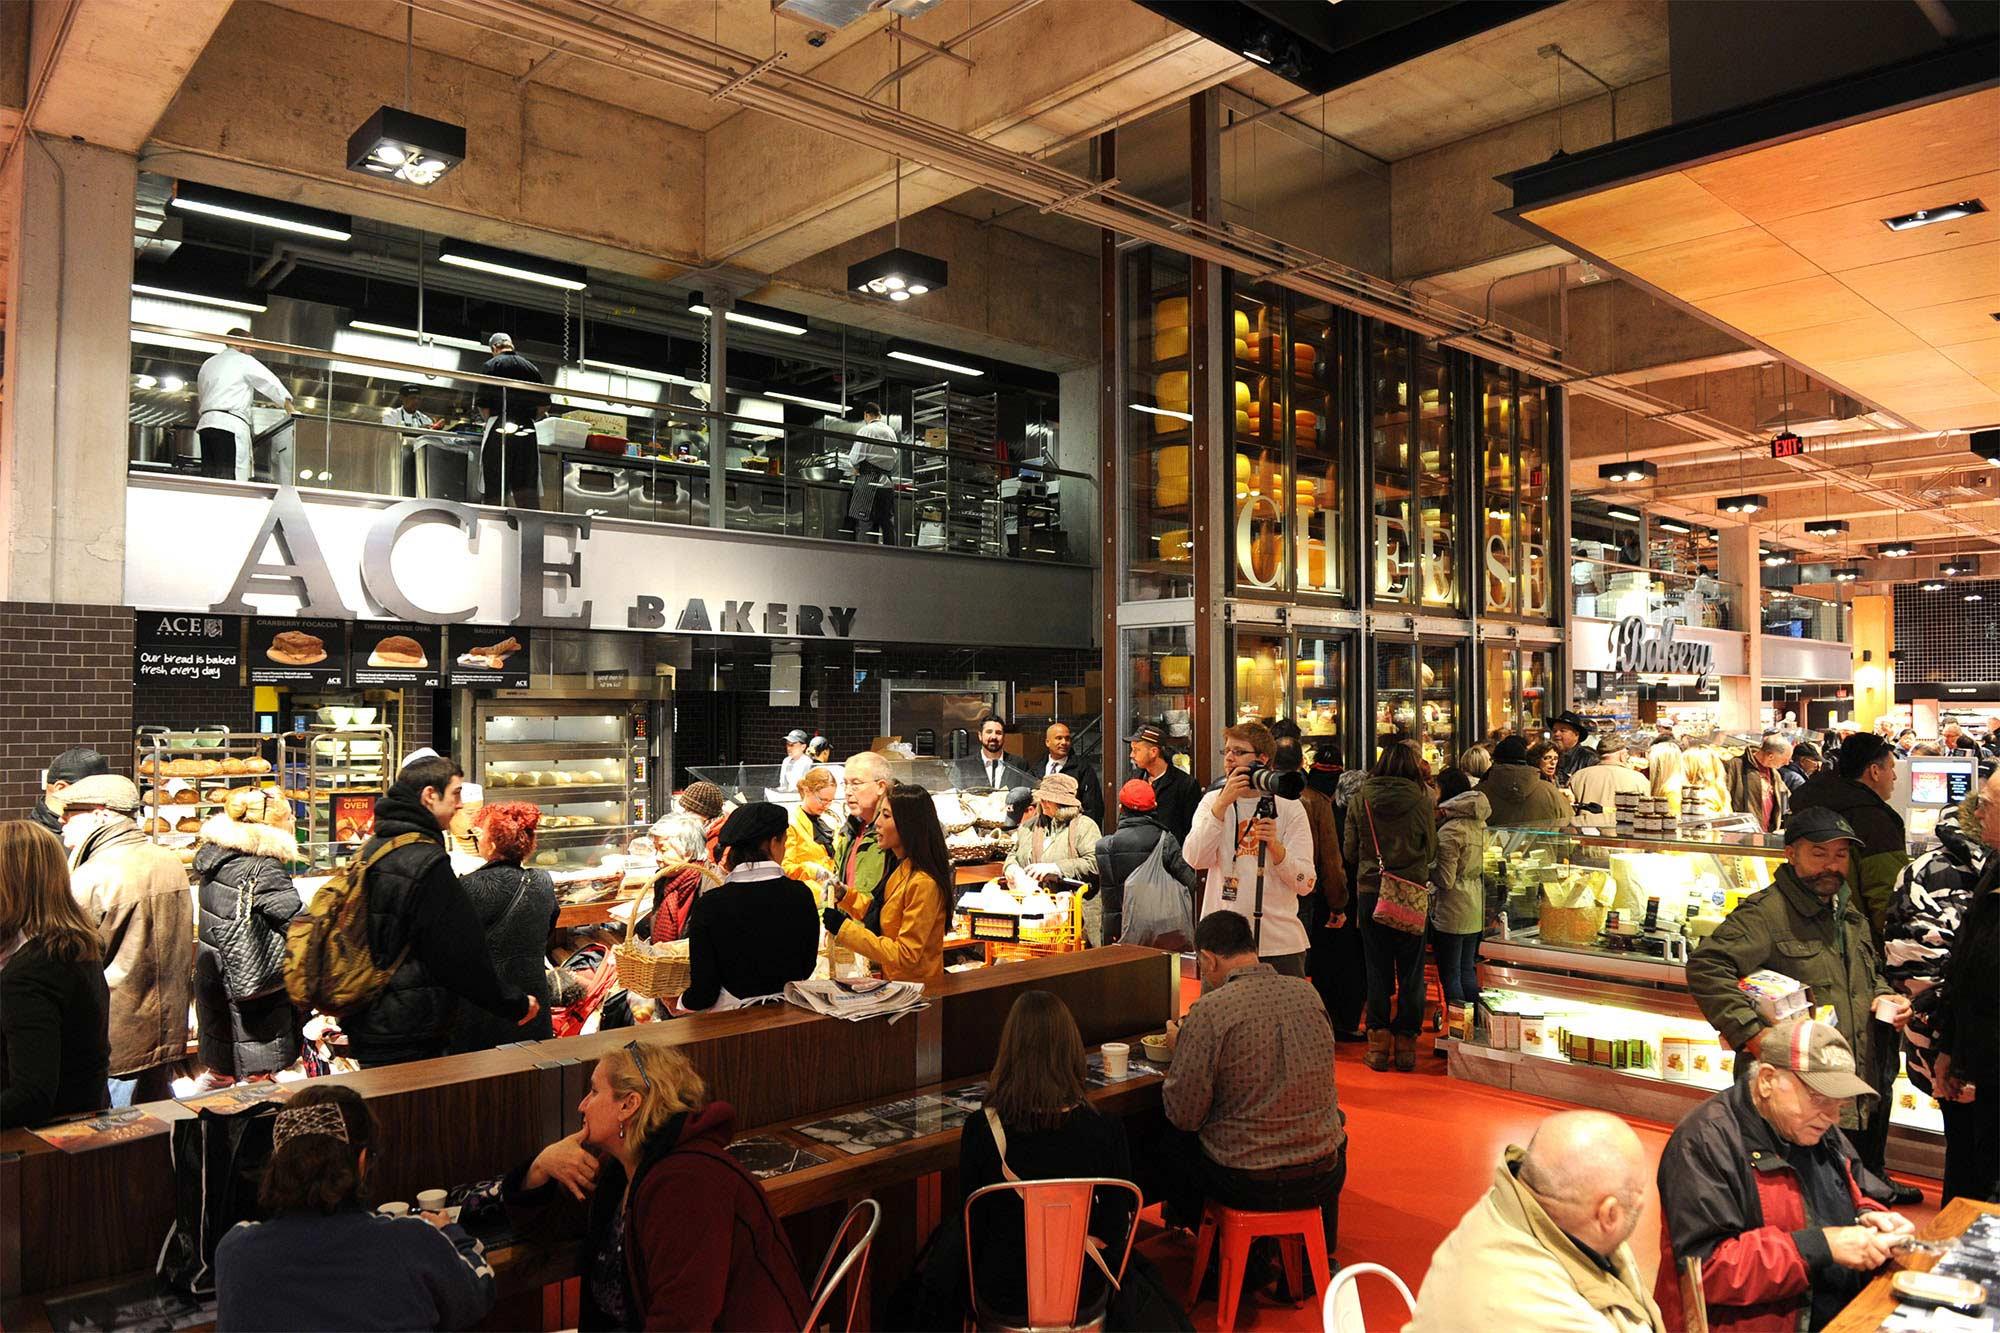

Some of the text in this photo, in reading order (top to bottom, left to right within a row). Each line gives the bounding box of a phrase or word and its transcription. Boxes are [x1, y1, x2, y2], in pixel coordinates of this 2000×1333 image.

[1775, 438, 1798, 457] EXIT
[1236, 495, 1548, 612] CHEESE
[208, 485, 857, 638] ACE BAKERY
[157, 617, 201, 632] ACE
[140, 652, 237, 666] Our bread is baked
[1608, 615, 1715, 692] Bakery
[140, 664, 221, 679] fresh every day
[326, 677, 342, 685] ACE
[424, 679, 439, 687] ACE
[515, 680, 528, 688] ACE
[343, 801, 369, 810] OVEN
